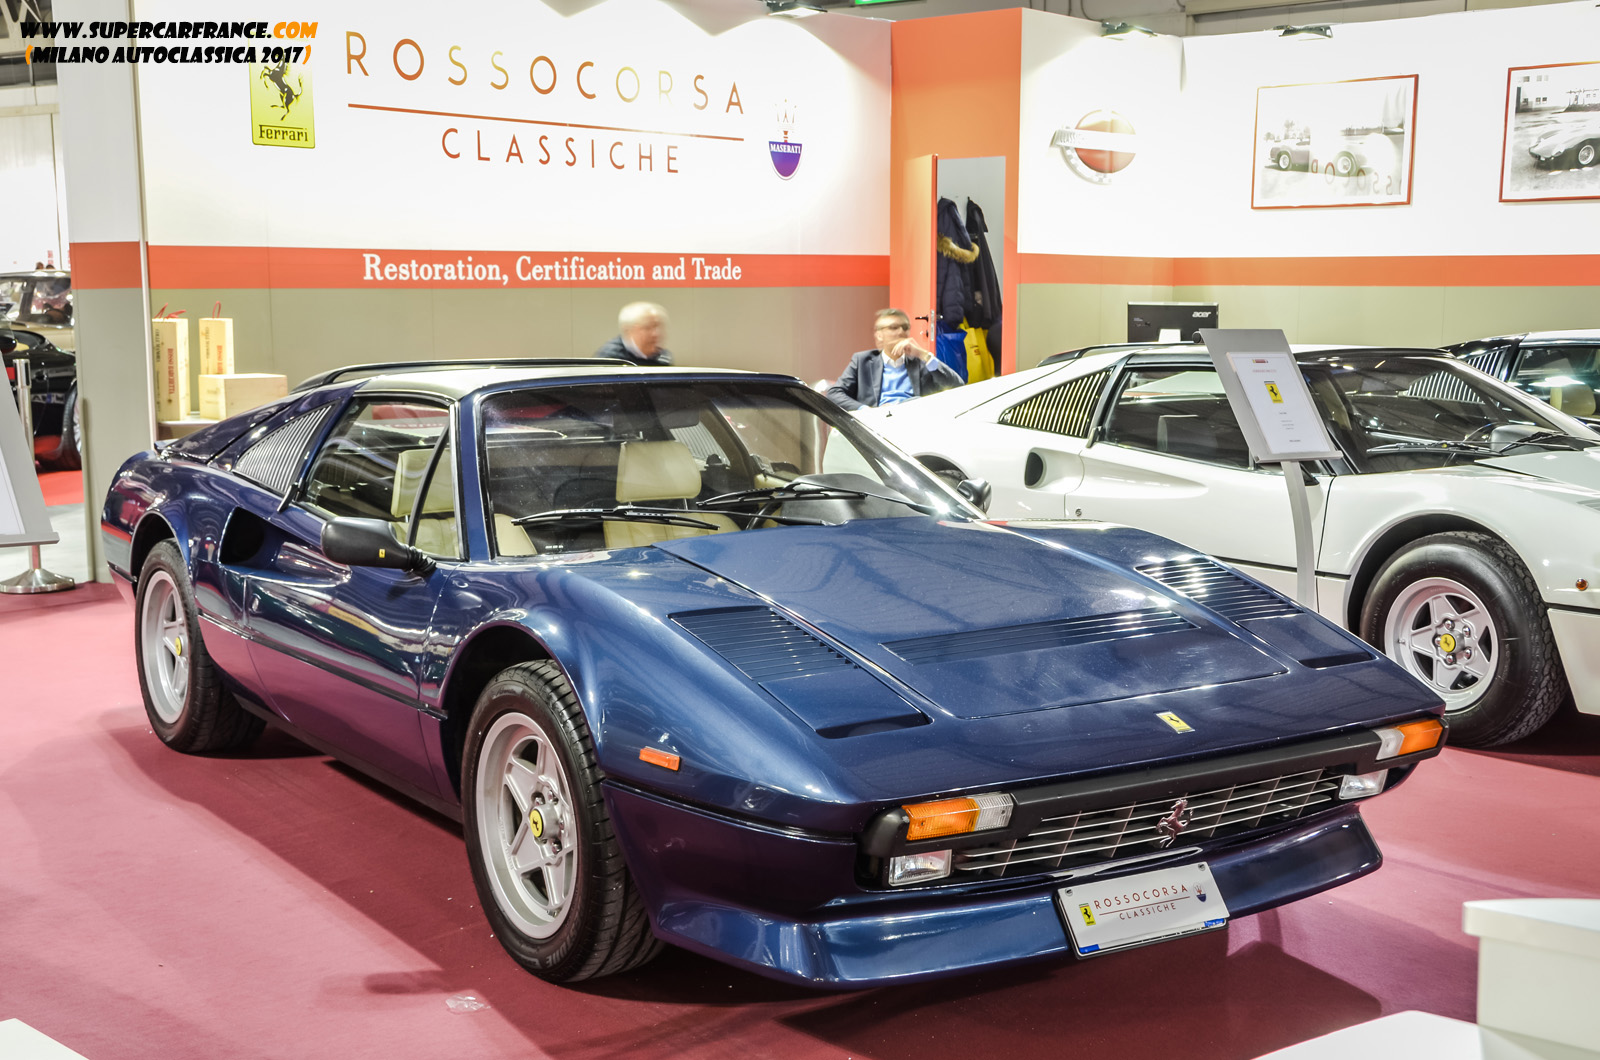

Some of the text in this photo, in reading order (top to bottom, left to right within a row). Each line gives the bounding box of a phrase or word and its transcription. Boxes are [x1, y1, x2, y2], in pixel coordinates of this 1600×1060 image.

[345, 31, 744, 115] ROSSOCORSA
[258, 125, 308, 142] Ferrari
[442, 128, 679, 173] CLASSICHE
[769, 143, 801, 154] MASERATI
[363, 253, 742, 285] Restoration, Certification and Trade
[1094, 884, 1189, 909] ROSSOCORSA
[1119, 902, 1177, 920] CLASSICHE
